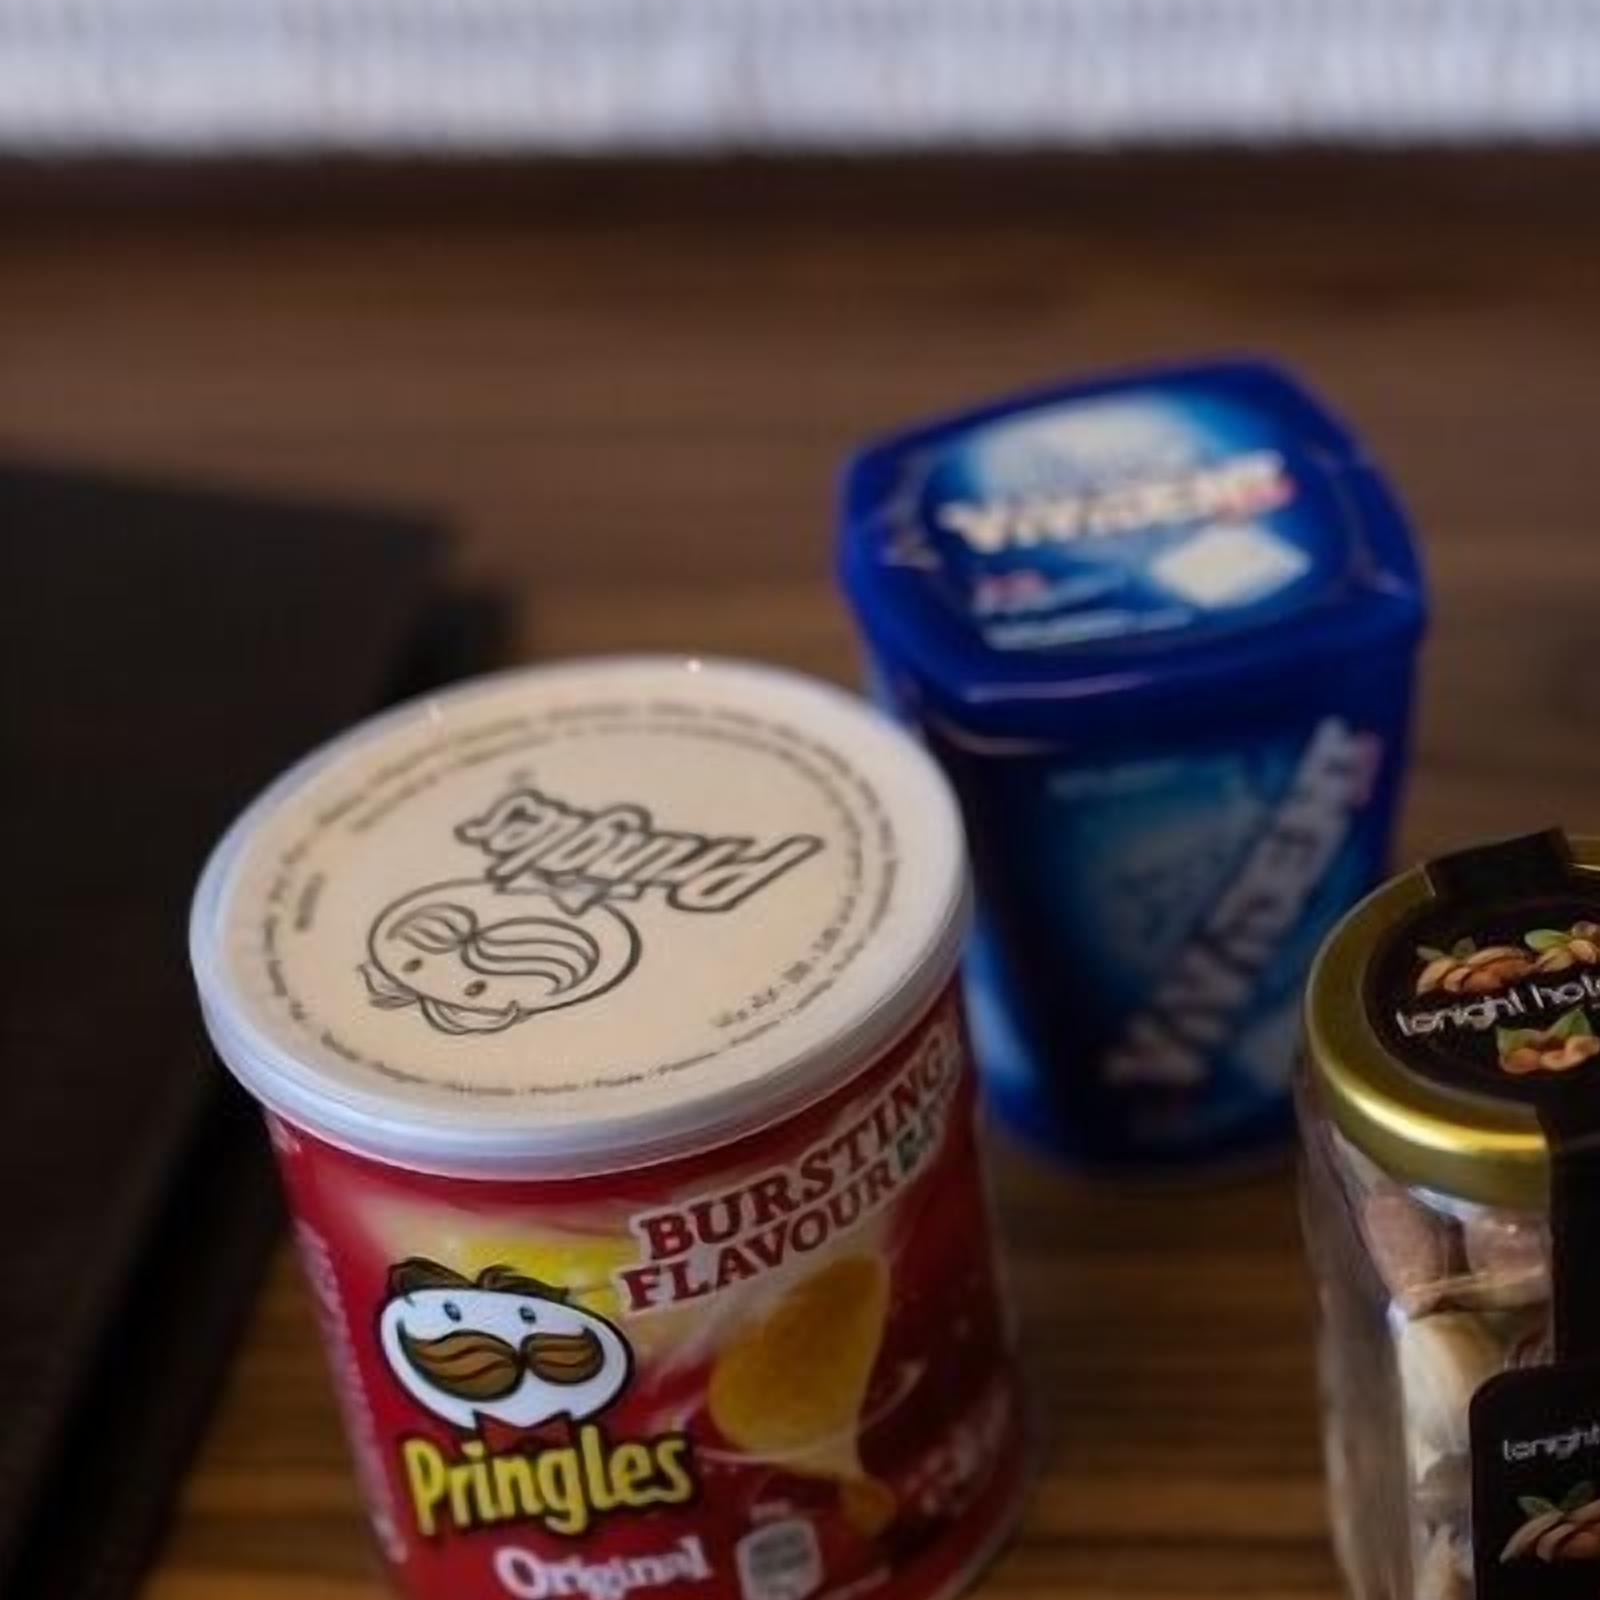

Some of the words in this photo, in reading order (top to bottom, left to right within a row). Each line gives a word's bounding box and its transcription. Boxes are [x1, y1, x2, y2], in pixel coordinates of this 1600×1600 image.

[640, 1033, 952, 1262] BURSTING
[620, 1160, 898, 1312] FLAVOUR
[402, 1422, 694, 1538] Pringles
